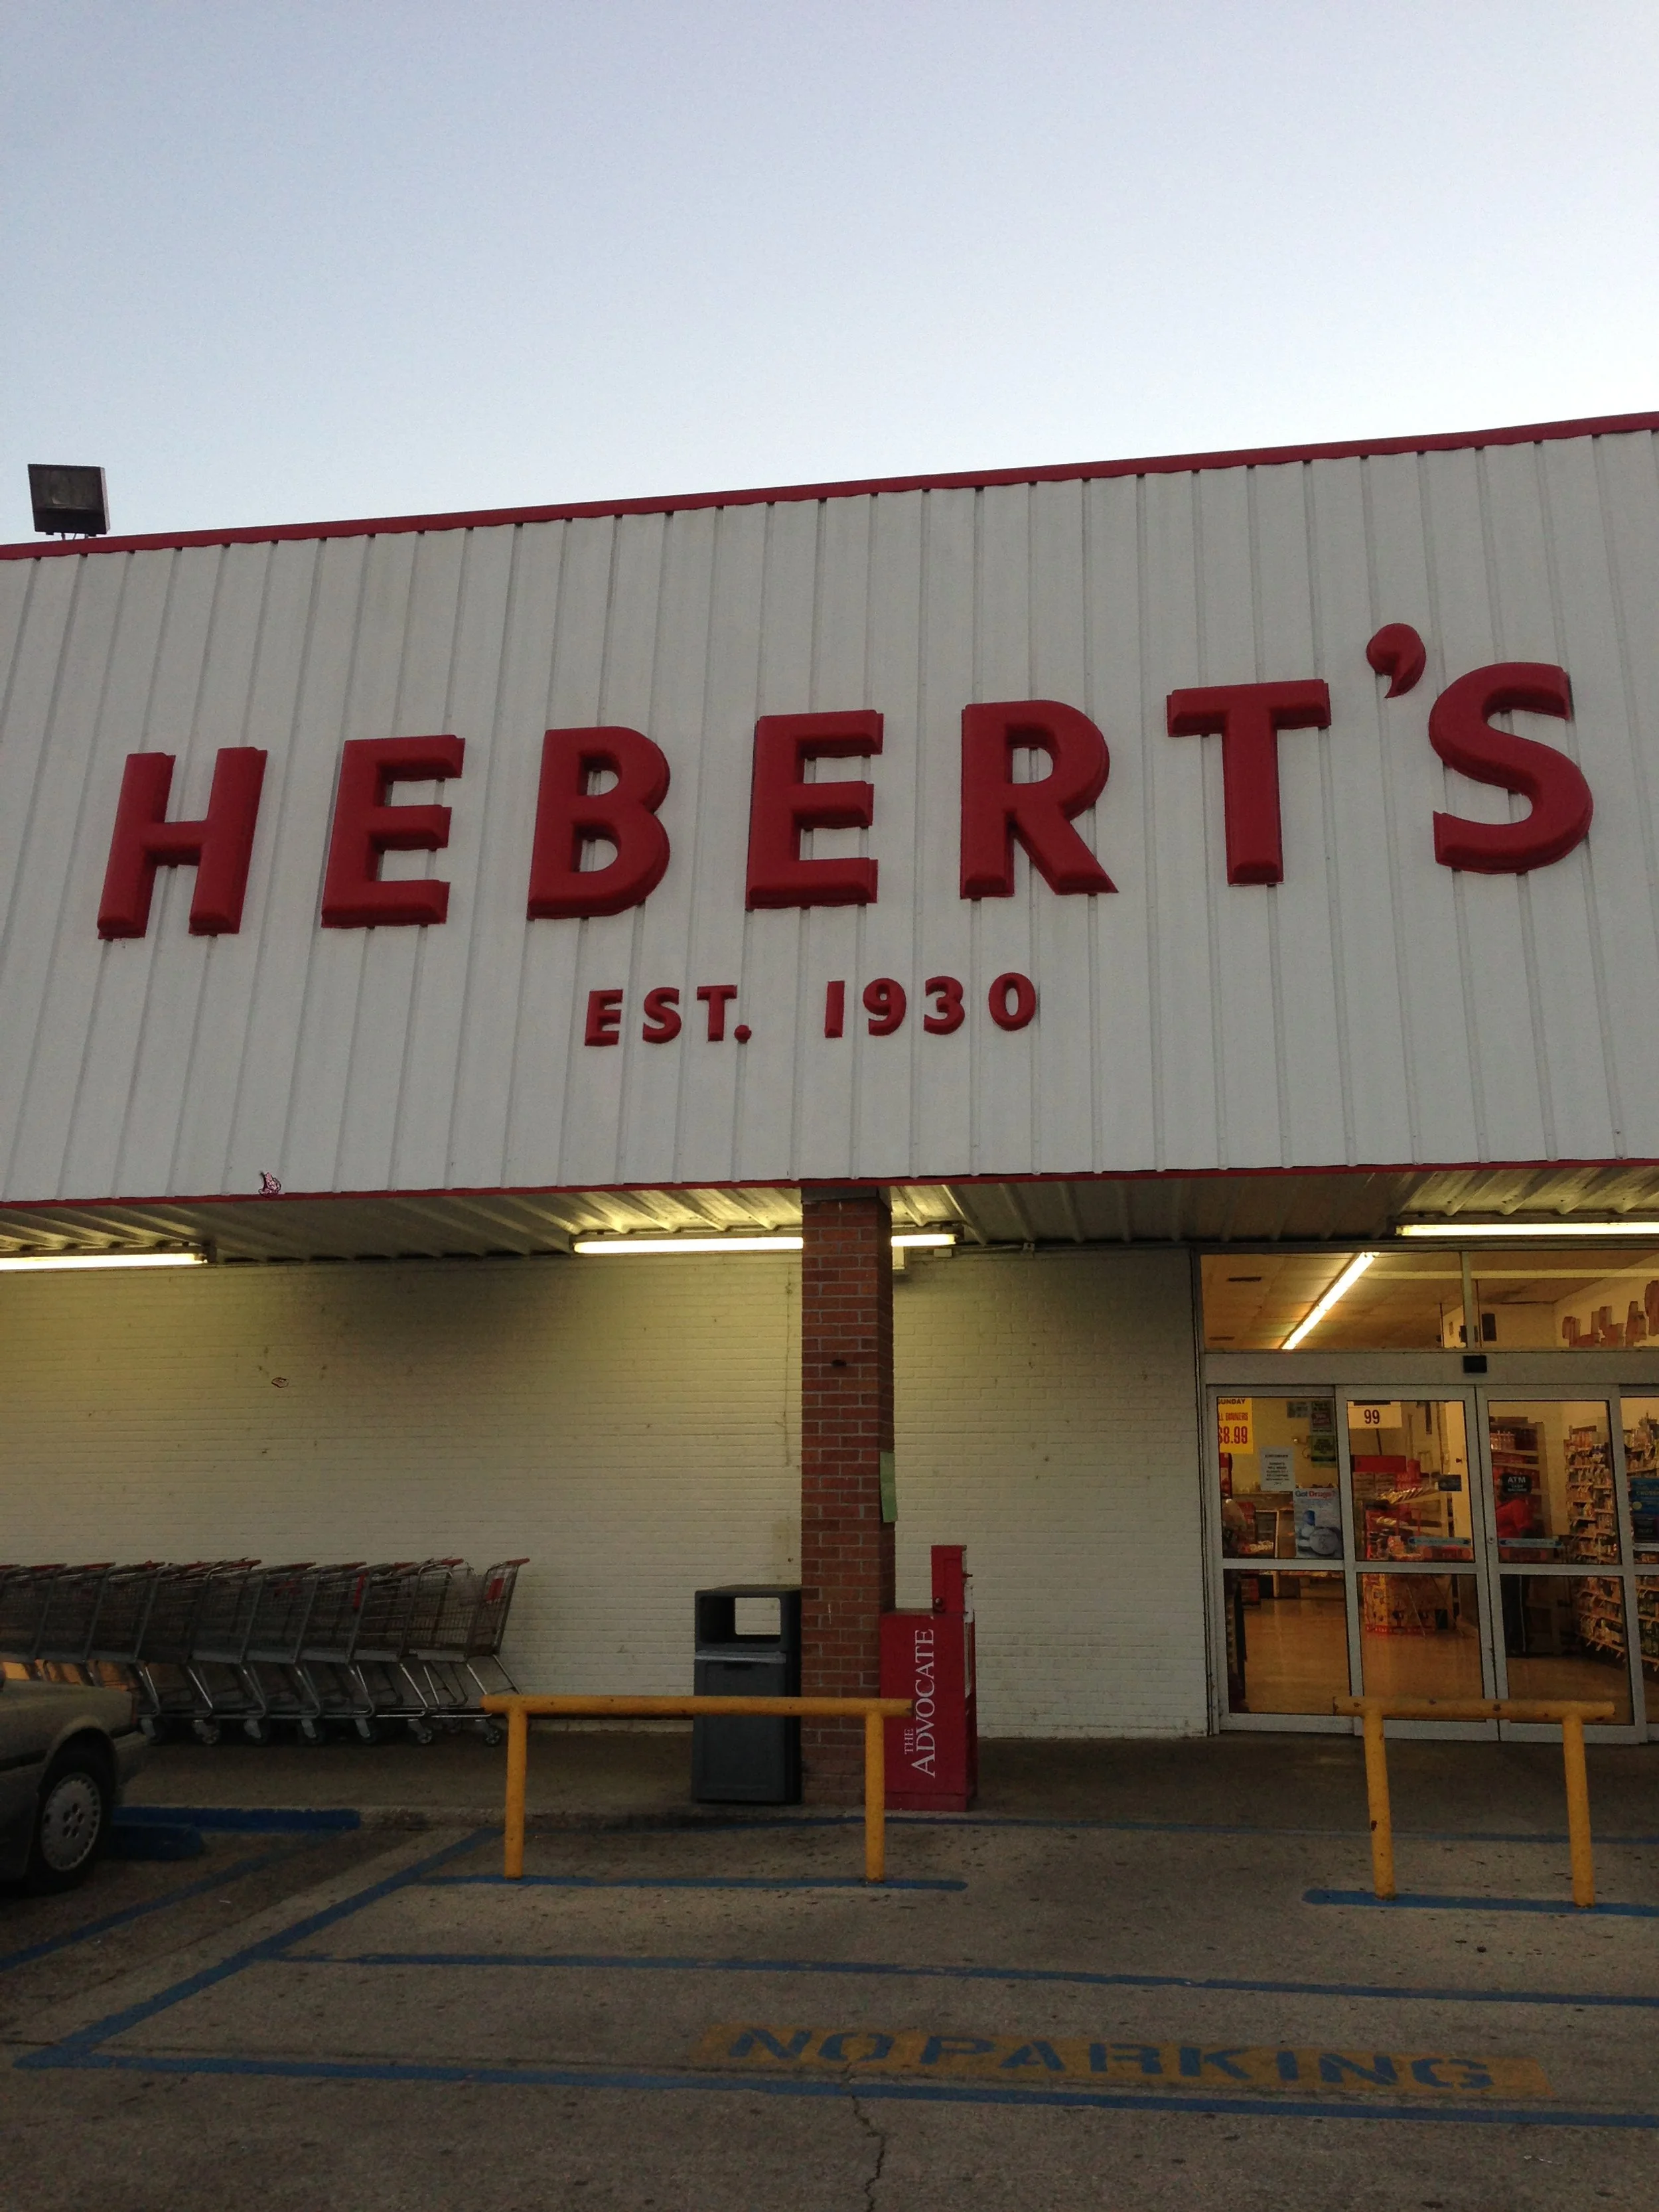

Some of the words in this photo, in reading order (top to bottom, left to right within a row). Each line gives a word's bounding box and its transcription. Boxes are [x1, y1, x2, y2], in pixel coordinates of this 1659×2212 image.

[98, 623, 1593, 939] HEBERT'S
[585, 984, 752, 1046] EST.
[824, 972, 1037, 1037] 1930
[1364, 1409, 1380, 1424] 99
[910, 1629, 936, 1779] ADVOCATE
[904, 1728, 914, 1755] THE
[729, 2028, 895, 2061] NO
[920, 2035, 1494, 2089] PARKING
